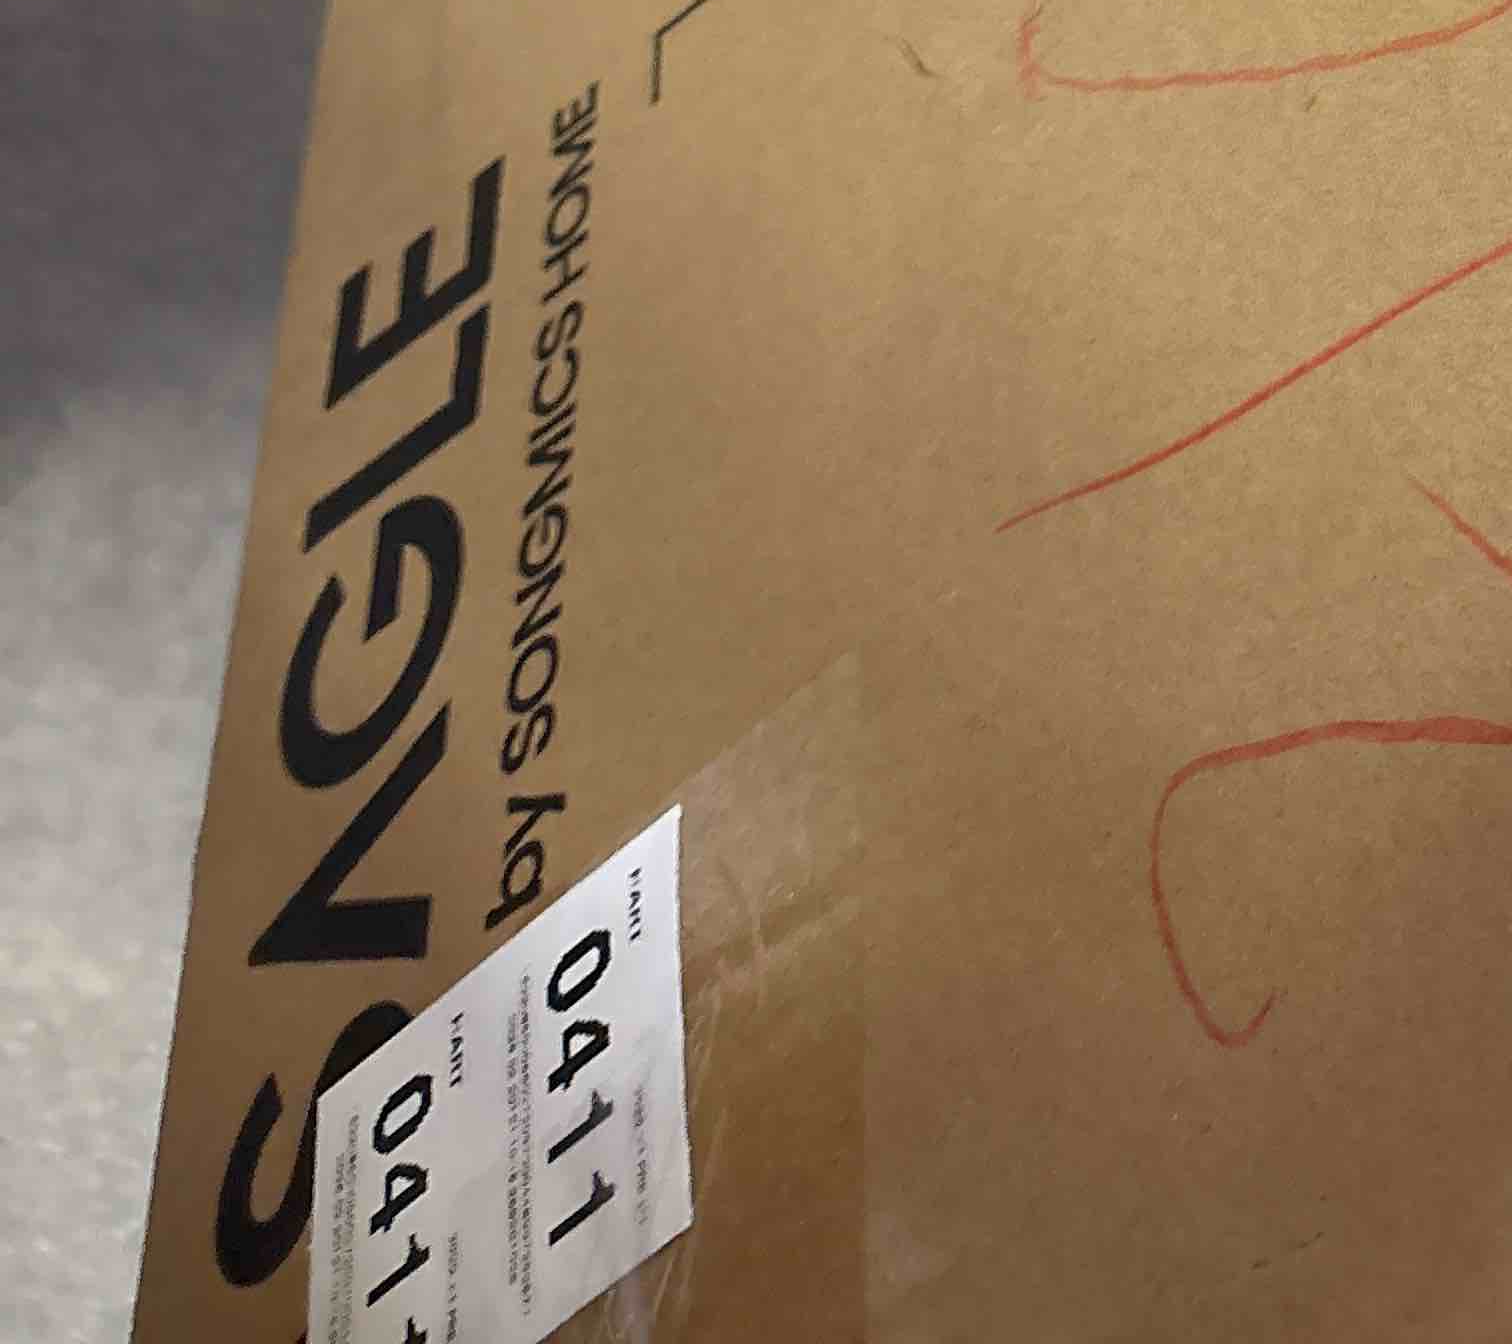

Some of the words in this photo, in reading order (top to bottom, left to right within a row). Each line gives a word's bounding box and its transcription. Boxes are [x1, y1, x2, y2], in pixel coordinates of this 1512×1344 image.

[542, 79, 600, 305] HOME
[500, 300, 587, 777] SONGMICS
[215, 154, 507, 1344] SAGLE
[485, 791, 568, 931] by
[365, 1073, 435, 1344] 041
[545, 928, 617, 1248] 0411
